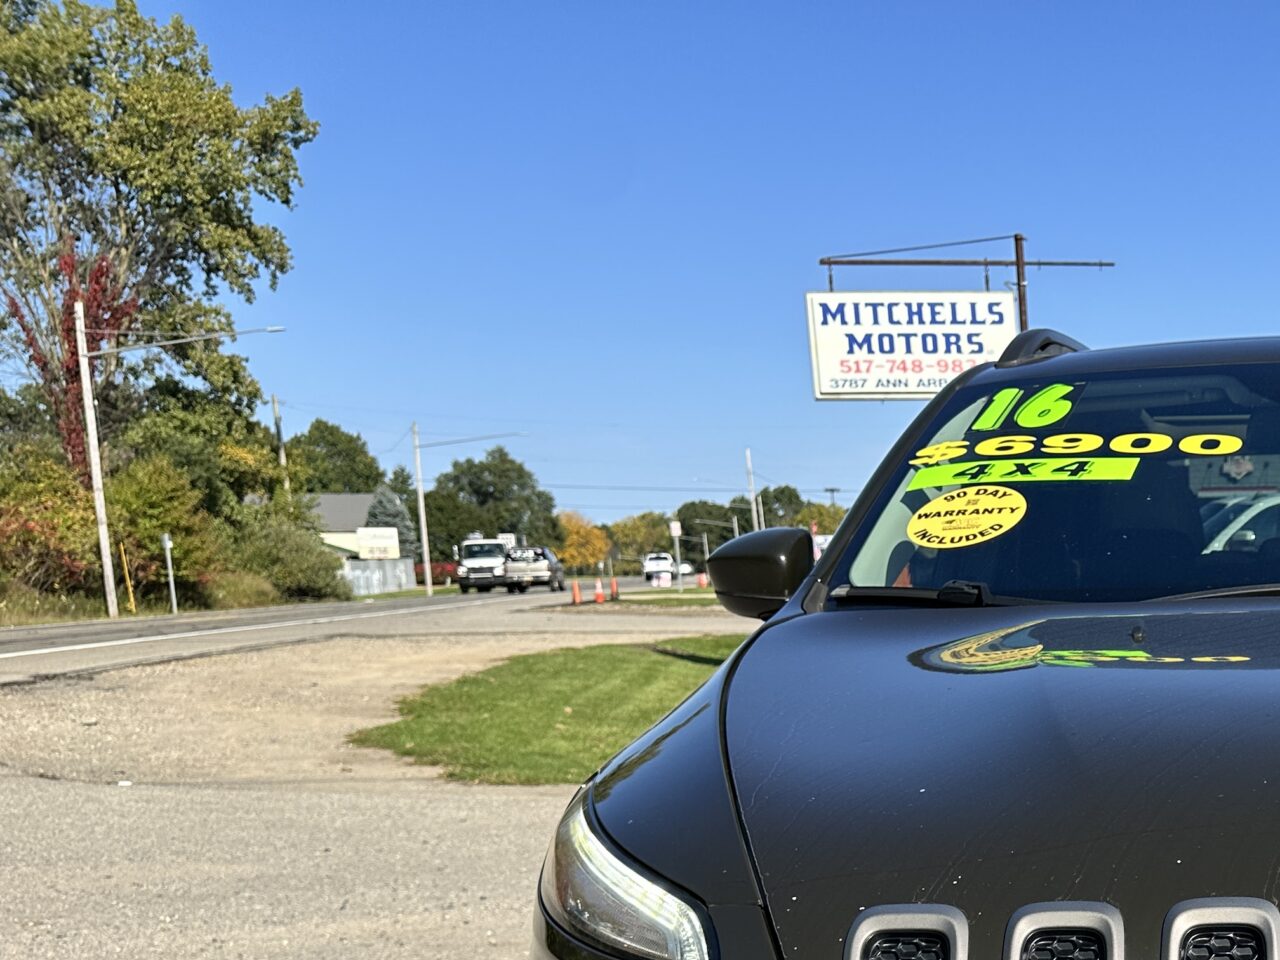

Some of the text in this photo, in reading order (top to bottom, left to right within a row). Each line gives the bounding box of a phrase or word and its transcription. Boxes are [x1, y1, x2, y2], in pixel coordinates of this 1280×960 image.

[819, 302, 1004, 326] MITCHELLS
[845, 333, 984, 355] MOTORS
[839, 359, 987, 374] 517-748-98
[829, 378, 867, 389] 3787
[875, 378, 909, 388] ANN
[971, 383, 1075, 431] 16
[909, 433, 1243, 466] $6900
[943, 488, 1014, 502] 90 DAY
[917, 506, 1021, 520] WARRANTY
[913, 523, 1004, 544] INCLUDED
